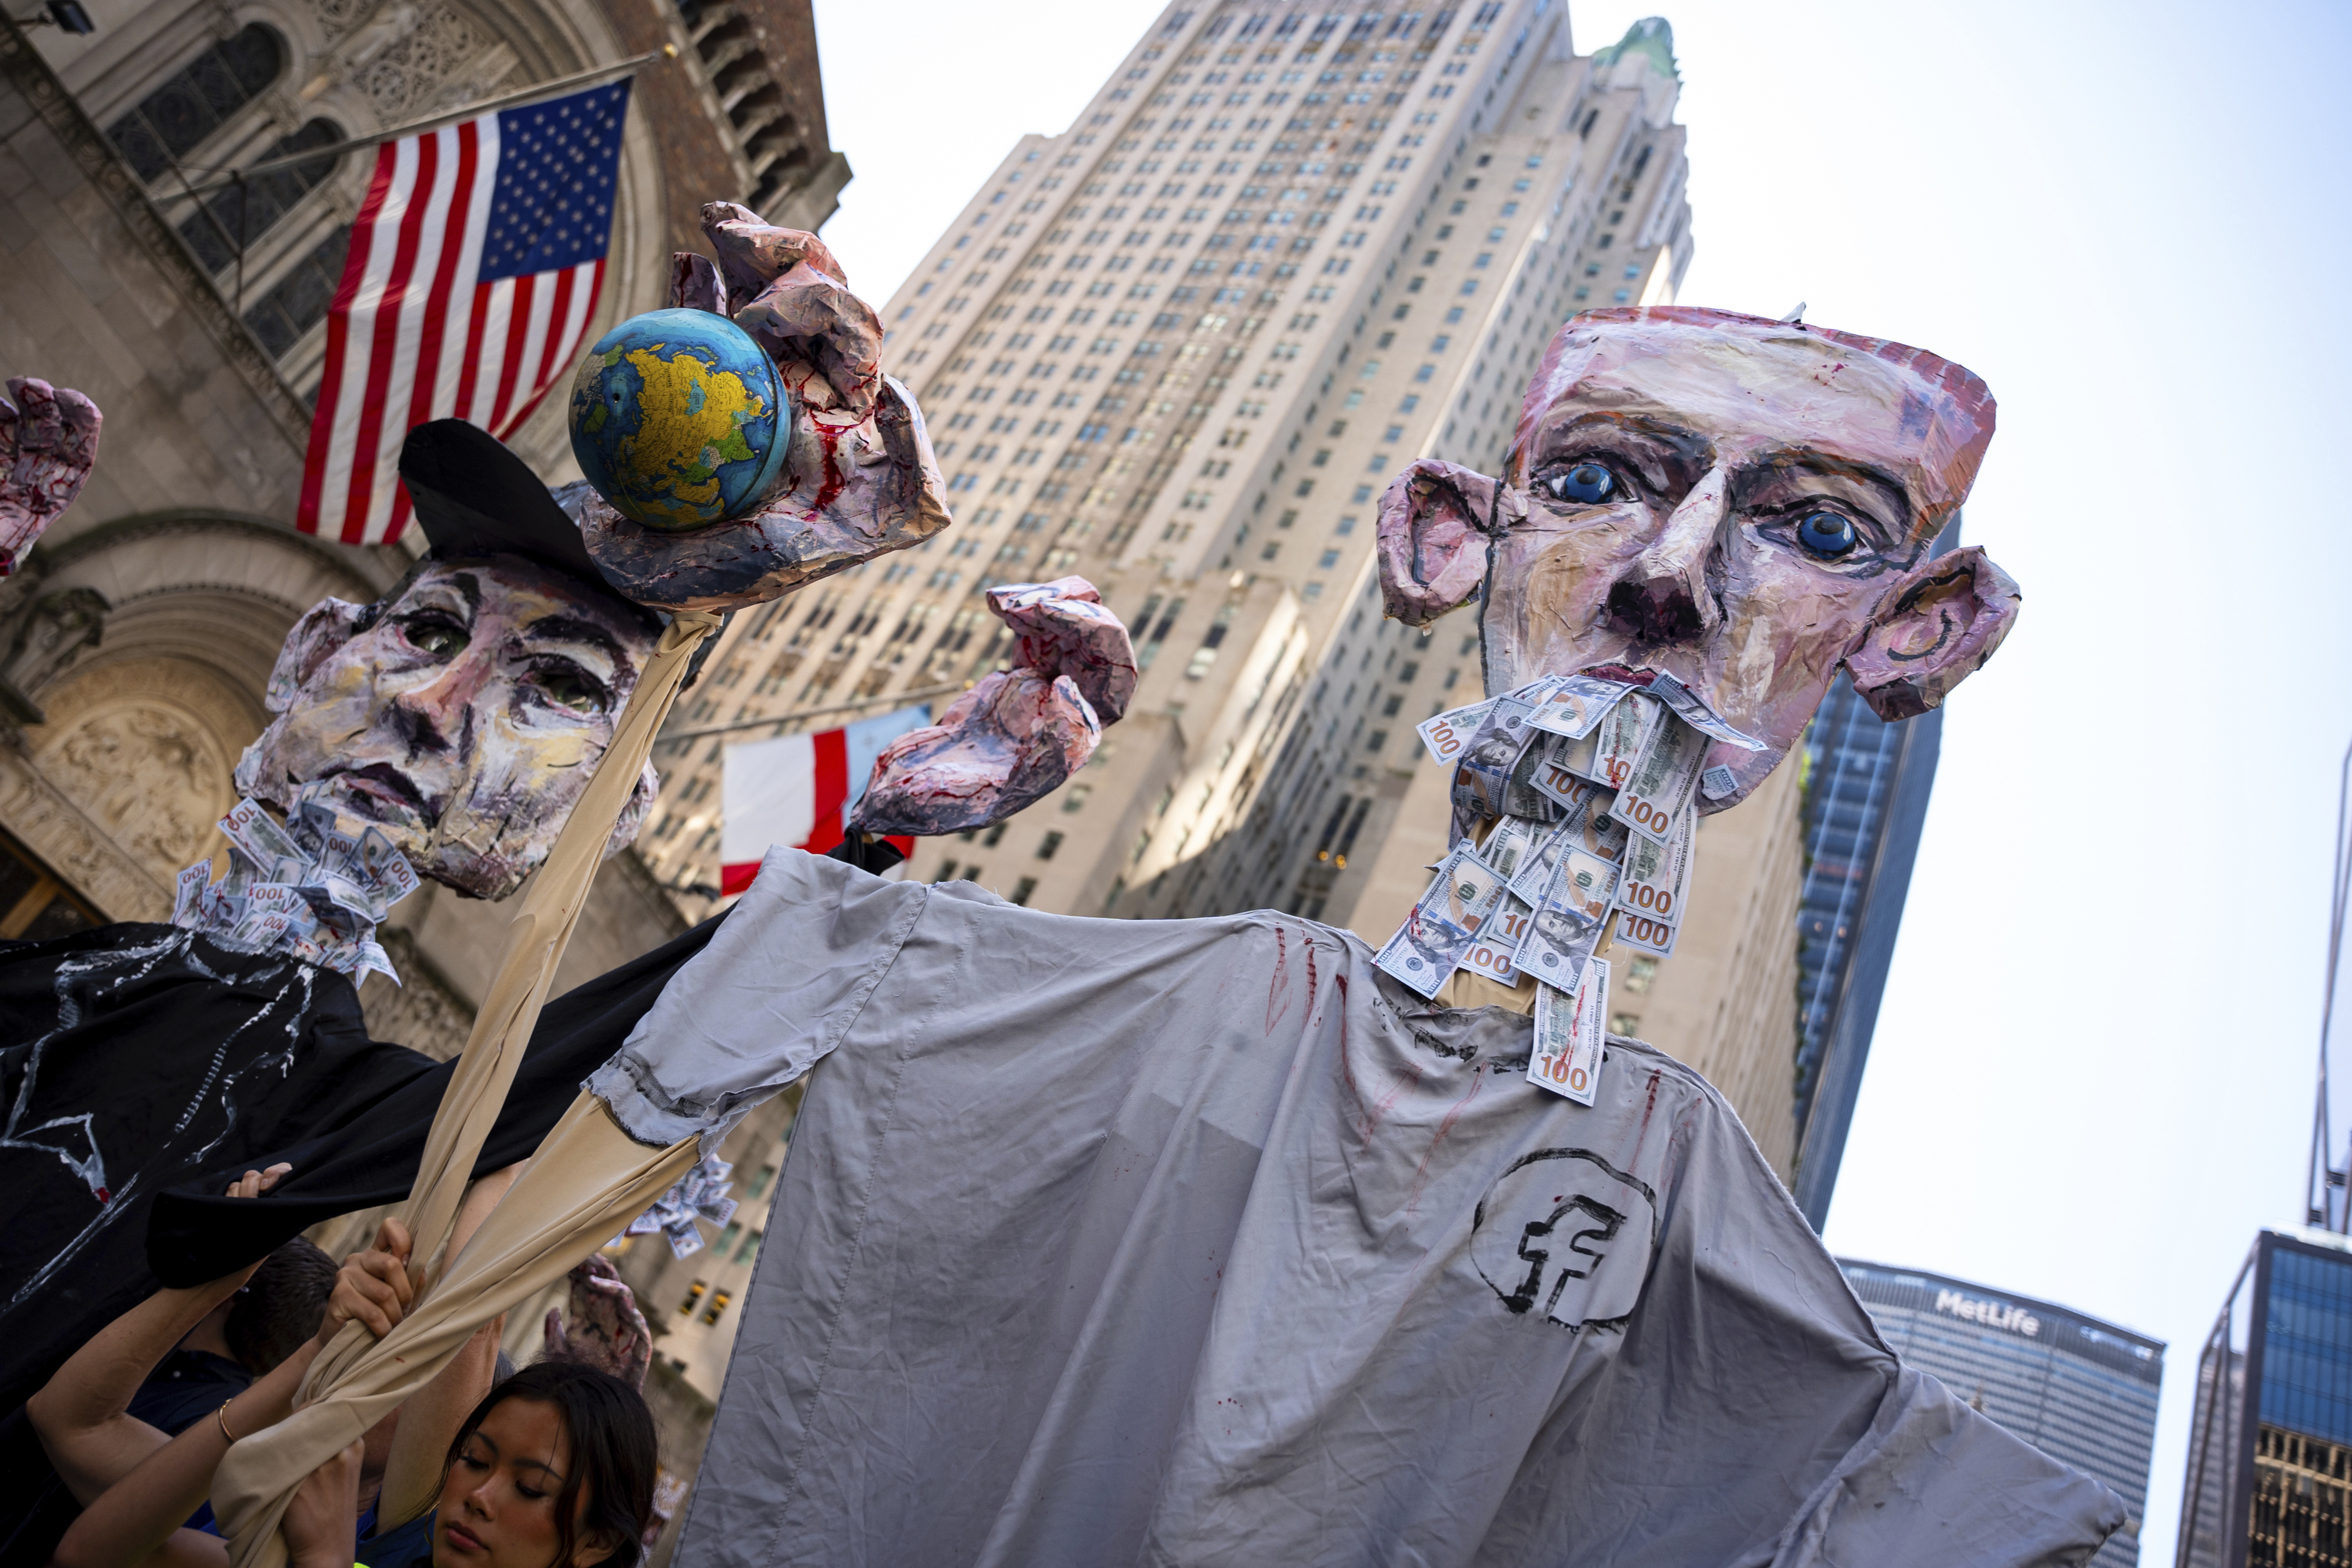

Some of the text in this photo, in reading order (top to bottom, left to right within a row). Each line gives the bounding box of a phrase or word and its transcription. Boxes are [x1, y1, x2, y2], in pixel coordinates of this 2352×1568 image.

[1429, 720, 1461, 754] 100
[1674, 783, 1683, 798] TRUST
[1626, 795, 1668, 834] 100
[182, 865, 209, 884] 100
[391, 861, 412, 890] 100
[1512, 872, 1527, 888] 100
[1522, 870, 1543, 894] EG92727792
[1603, 871, 1618, 894] 100
[256, 888, 285, 900] 100
[1485, 883, 1505, 909] 100
[1628, 881, 1672, 914] 100
[263, 916, 286, 930] 100
[1626, 915, 1669, 946] 100
[1378, 948, 1392, 964] 100
[1388, 944, 1408, 970] EG92727792
[1515, 947, 1528, 964] 100
[1526, 942, 1542, 968] EG92727792
[1568, 971, 1581, 989] 100
[1594, 962, 1605, 977] 100
[1426, 977, 1442, 994] 100
[1588, 1028, 1592, 1036] WE
[1541, 1055, 1587, 1091] 100
[1935, 1289, 2040, 1336] MetLife
